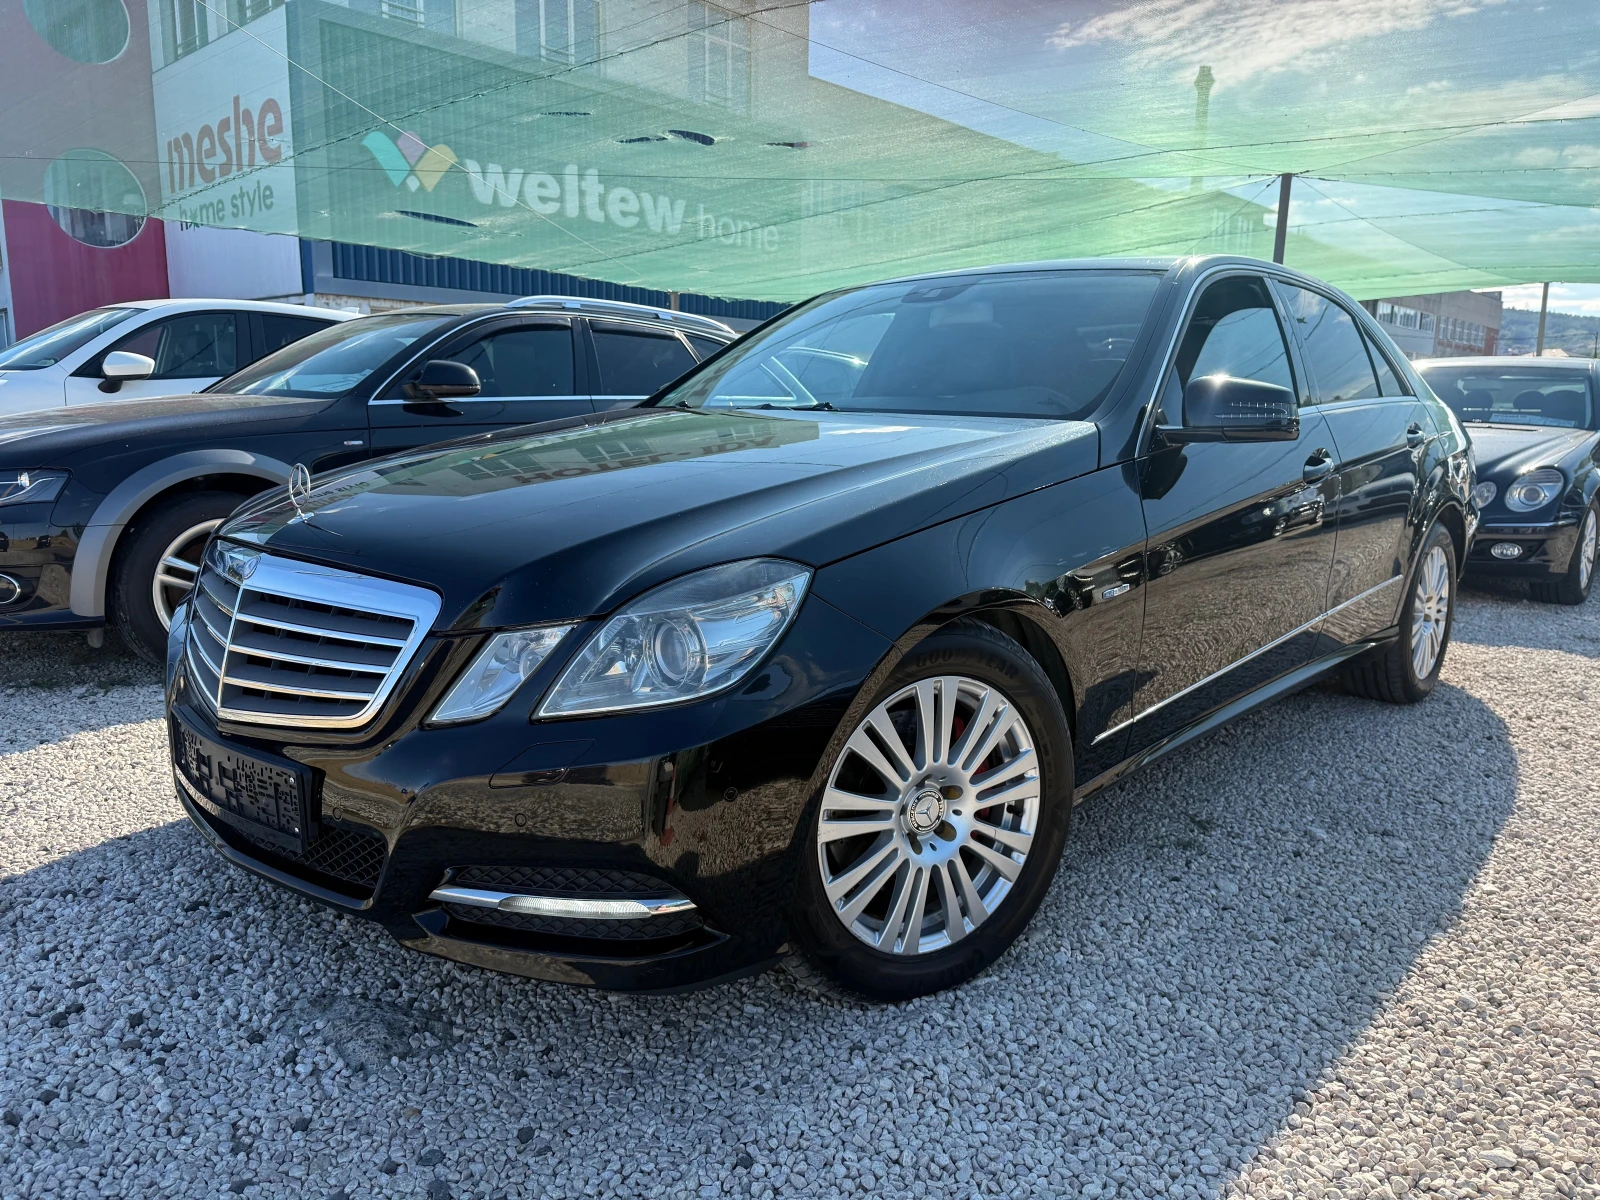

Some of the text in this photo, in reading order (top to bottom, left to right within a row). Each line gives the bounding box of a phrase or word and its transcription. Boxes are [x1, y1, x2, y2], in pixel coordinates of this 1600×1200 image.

[167, 94, 283, 194] meshe
[230, 180, 274, 218] style
[465, 158, 779, 251] weltew home
